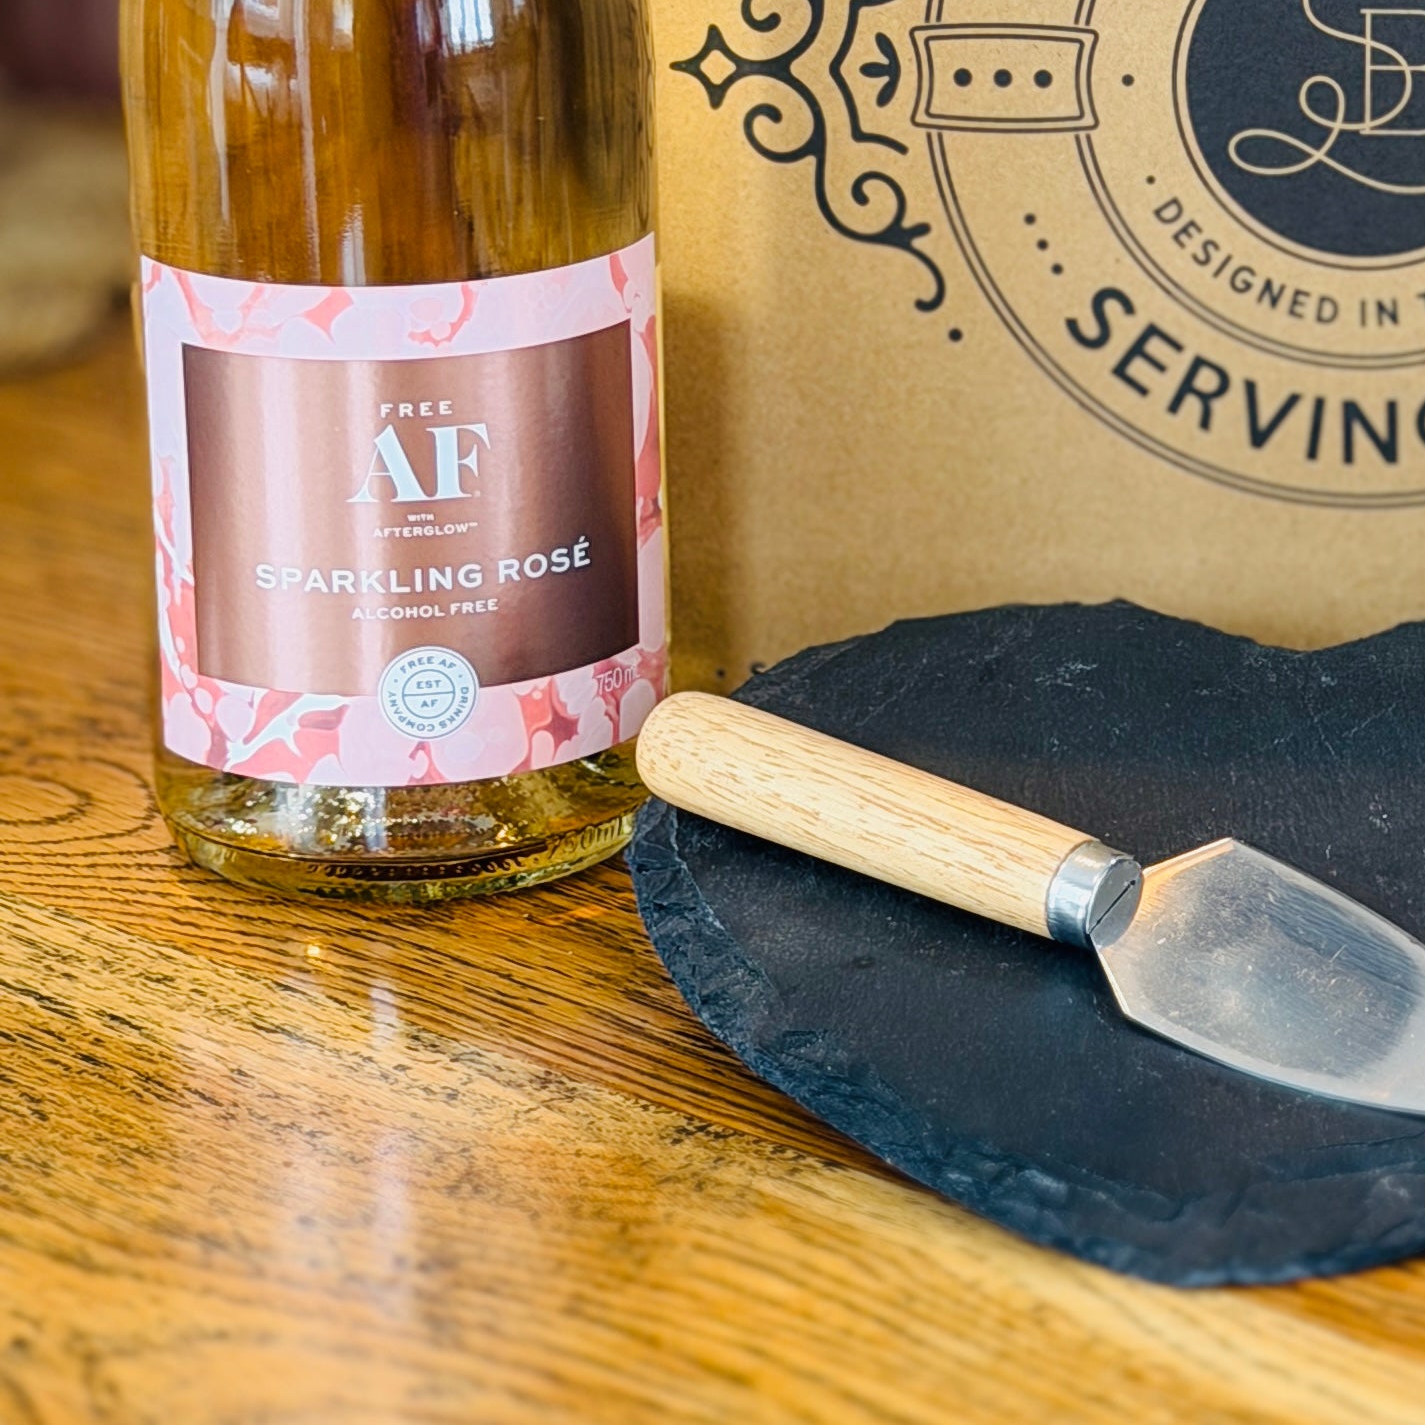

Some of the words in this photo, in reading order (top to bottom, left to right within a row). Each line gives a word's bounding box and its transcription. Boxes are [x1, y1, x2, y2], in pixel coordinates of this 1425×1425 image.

[1153, 197, 1339, 326] DESIGNED
[1360, 299, 1399, 326] IN
[380, 401, 453, 418] FREE
[346, 423, 491, 503] AF
[407, 513, 435, 522] WITH
[255, 563, 483, 594] SPARKLING
[498, 536, 592, 584] ROSÉ
[352, 604, 445, 620] ALCOHOL
[450, 598, 498, 616] FREE
[400, 656, 435, 674] FREE
[438, 658, 457, 669] AF
[416, 680, 442, 689] EST
[595, 667, 623, 695] 750
[387, 691, 436, 732] COMPANY
[420, 699, 438, 708] AF
[438, 686, 470, 729] DRINKS
